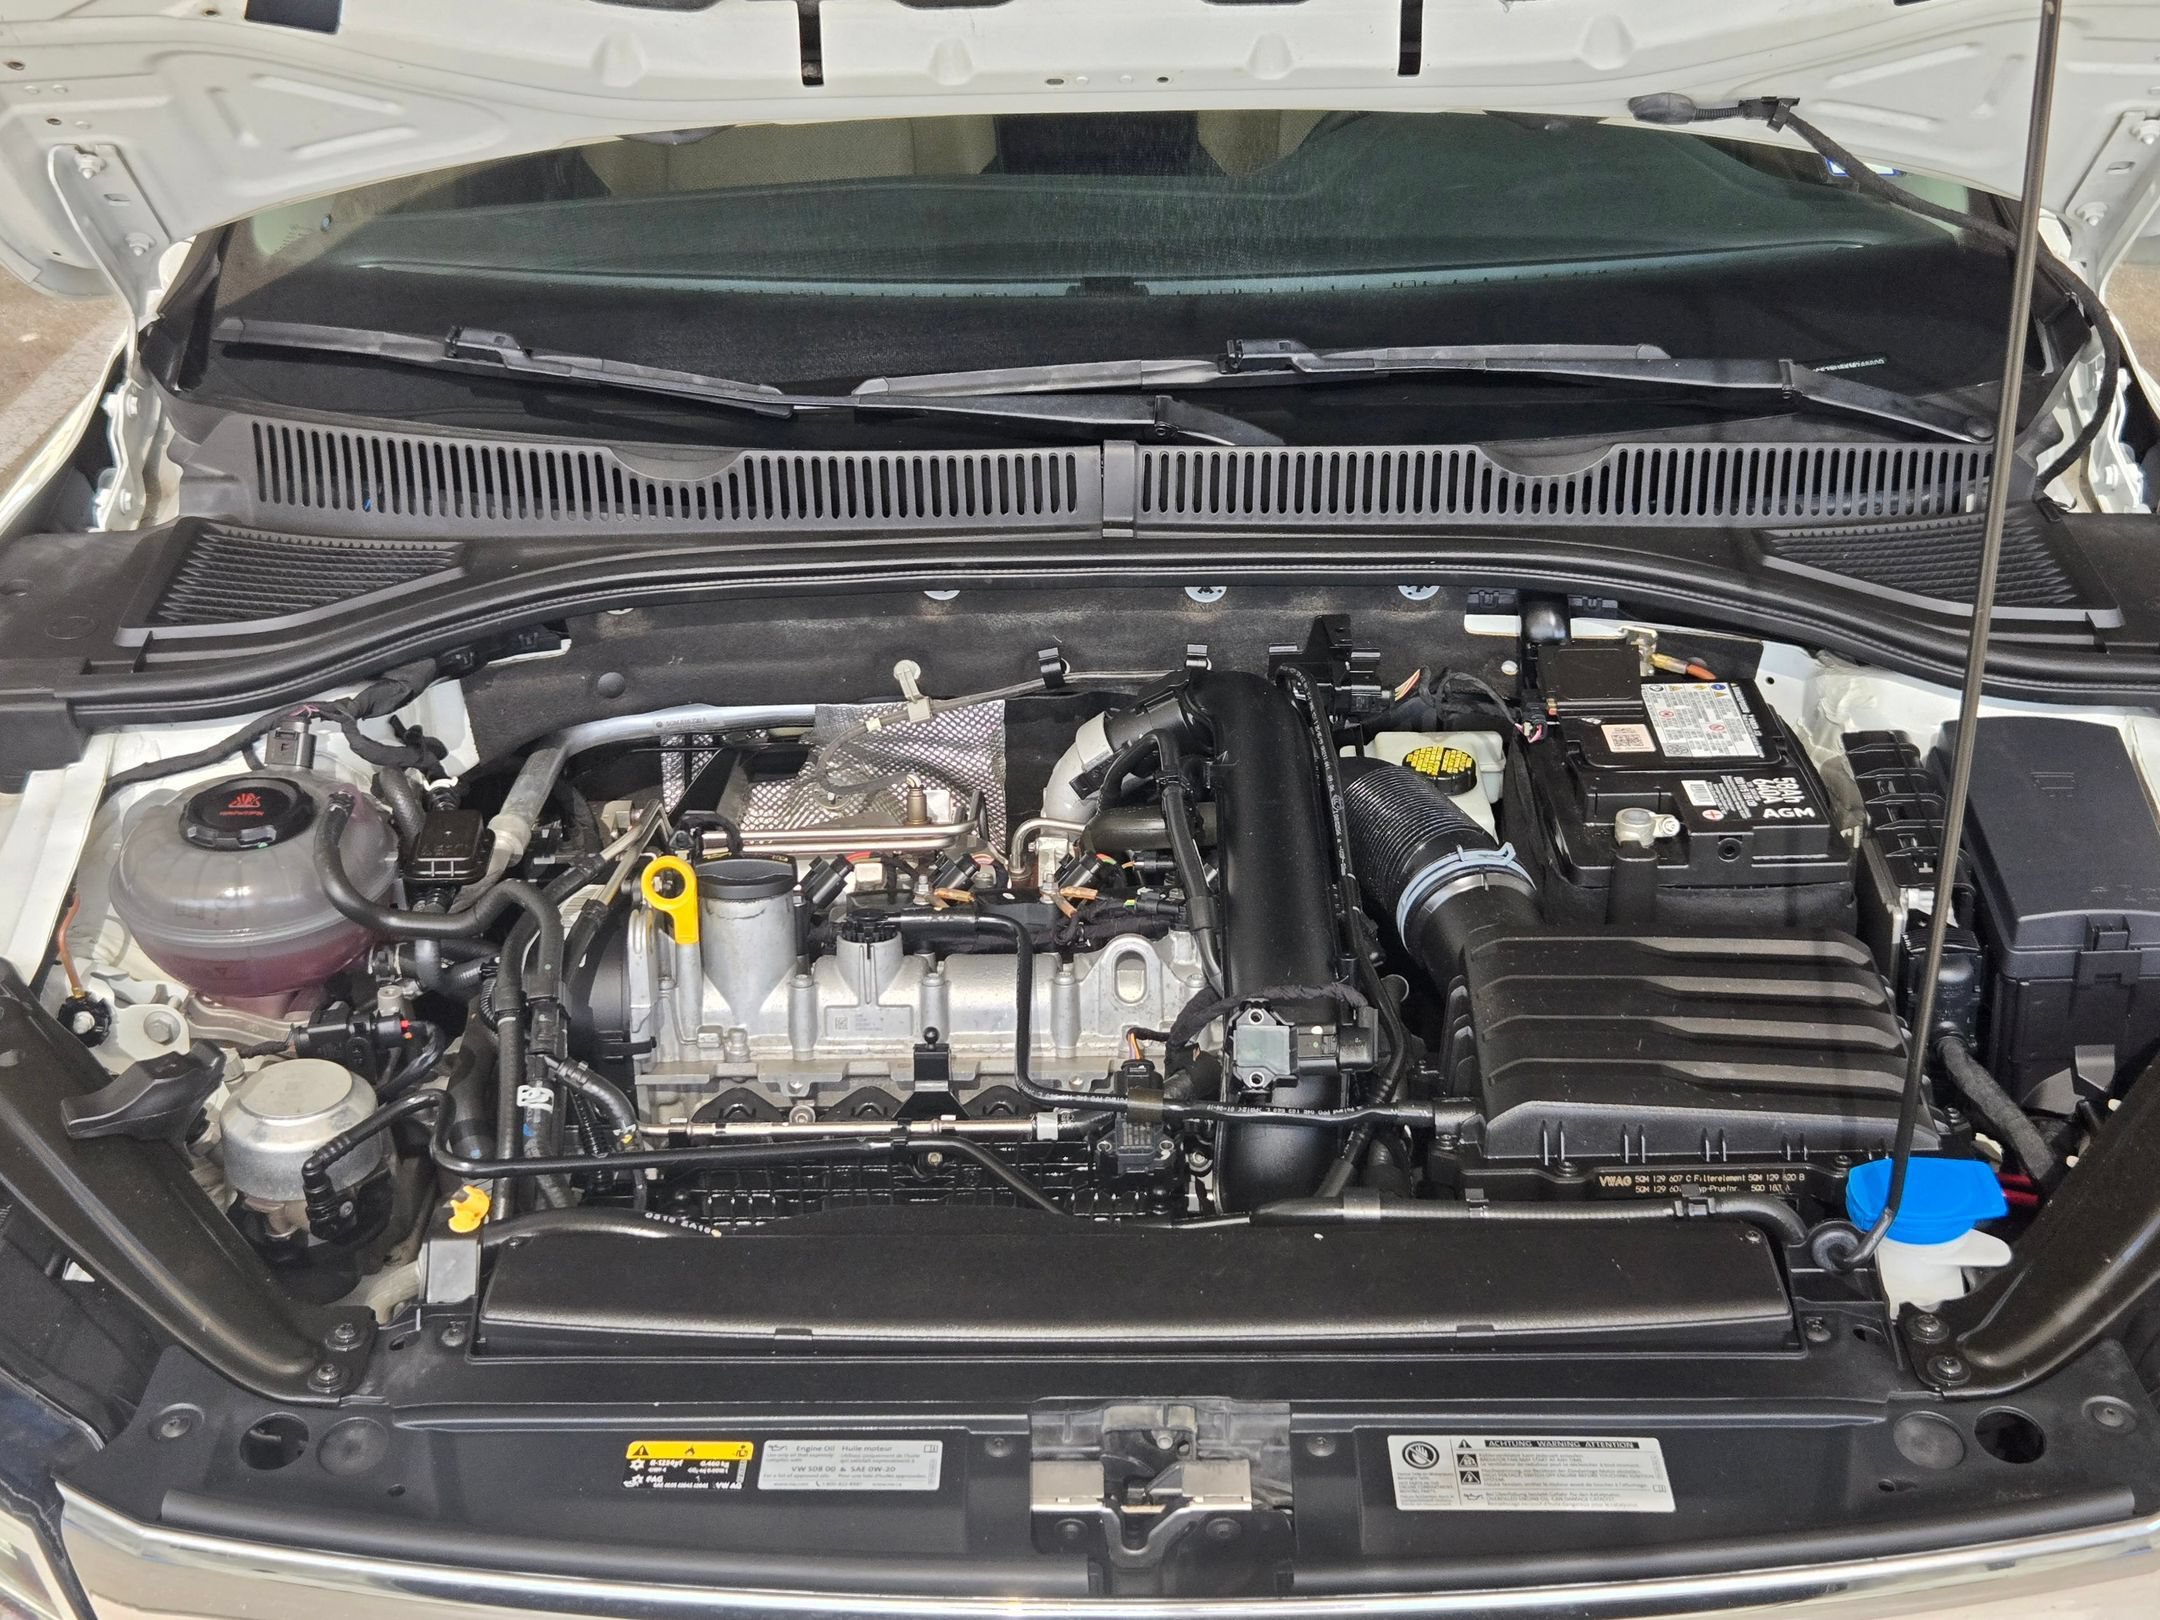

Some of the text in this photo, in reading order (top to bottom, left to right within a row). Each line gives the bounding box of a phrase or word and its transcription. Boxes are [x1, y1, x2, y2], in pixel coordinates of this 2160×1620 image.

[1752, 778, 1783, 804] 640A
[1773, 777, 1805, 803] 58Ah
[1763, 807, 1816, 819] AGM
[1653, 1174, 1666, 1183] 129
[1668, 1174, 1683, 1183] 607
[1685, 1174, 1692, 1182] C
[1766, 1173, 1779, 1181] 129
[1799, 1173, 1805, 1181] B
[1653, 1185, 1667, 1194] 129
[1488, 1440, 1633, 1449] ACHTUNG WARNING ATTENTION
